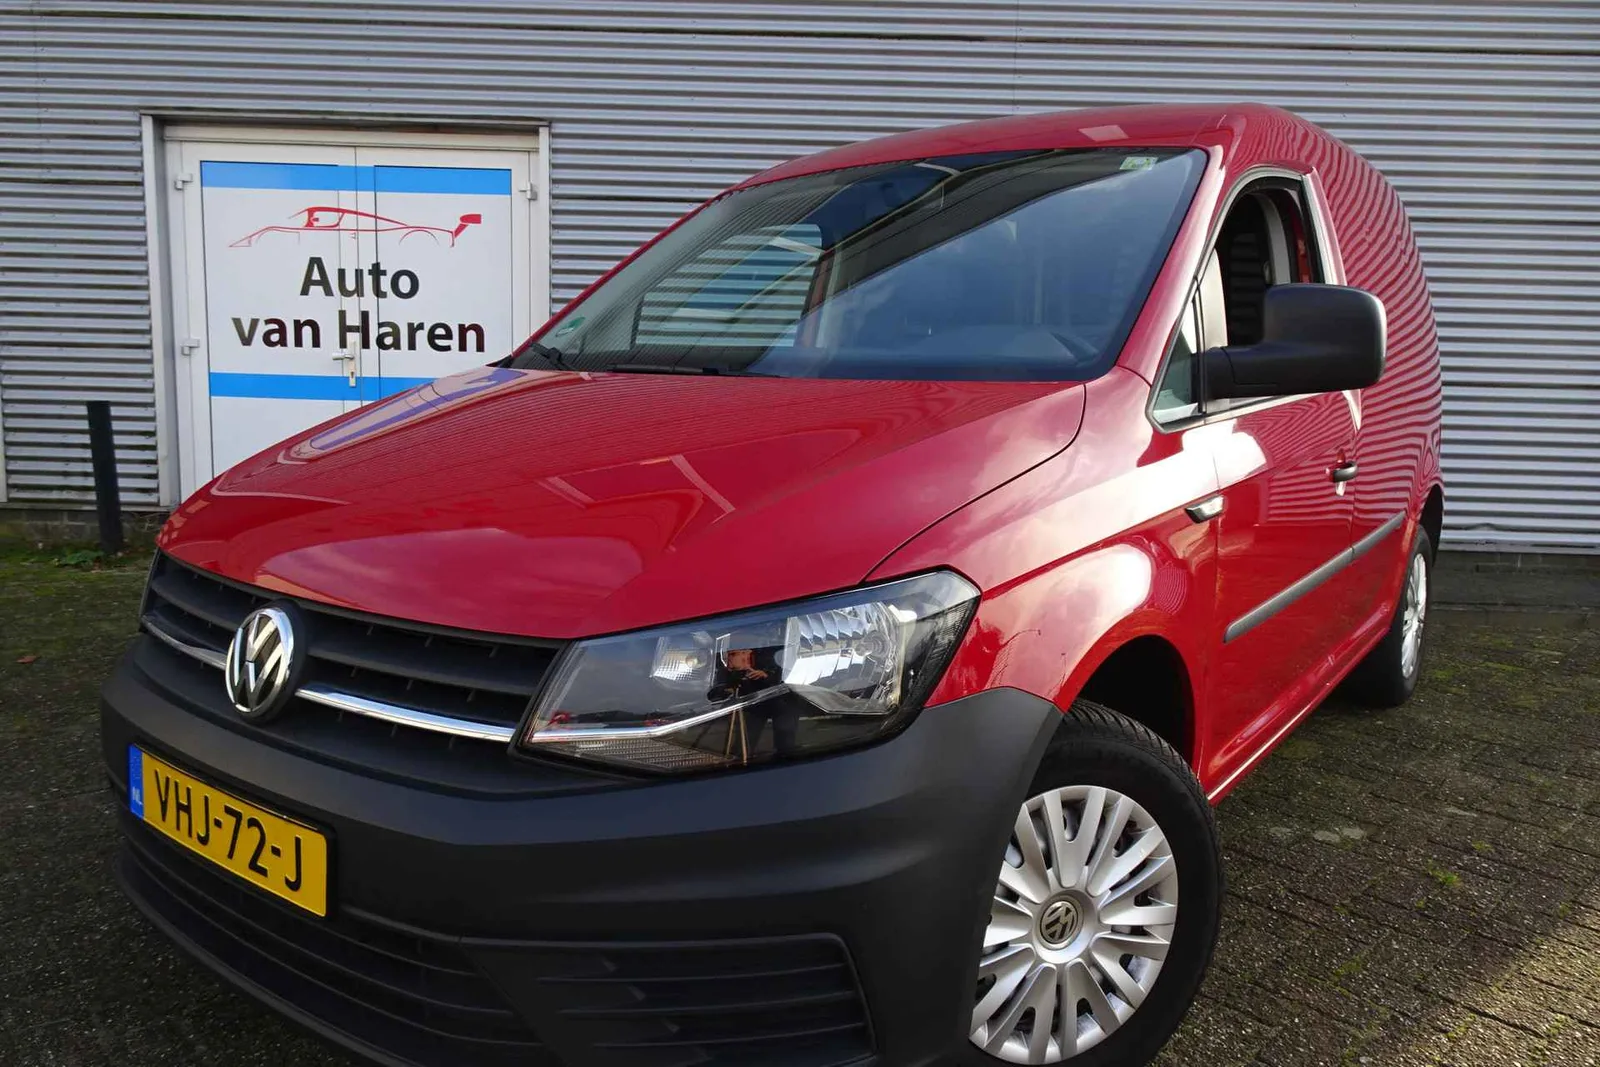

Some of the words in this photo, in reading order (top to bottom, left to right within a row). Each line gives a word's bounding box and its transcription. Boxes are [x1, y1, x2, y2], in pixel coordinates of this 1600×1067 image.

[300, 257, 419, 299] Auto
[231, 318, 321, 348] van
[338, 310, 485, 352] Haren
[155, 768, 302, 892] VHJ-72-J
